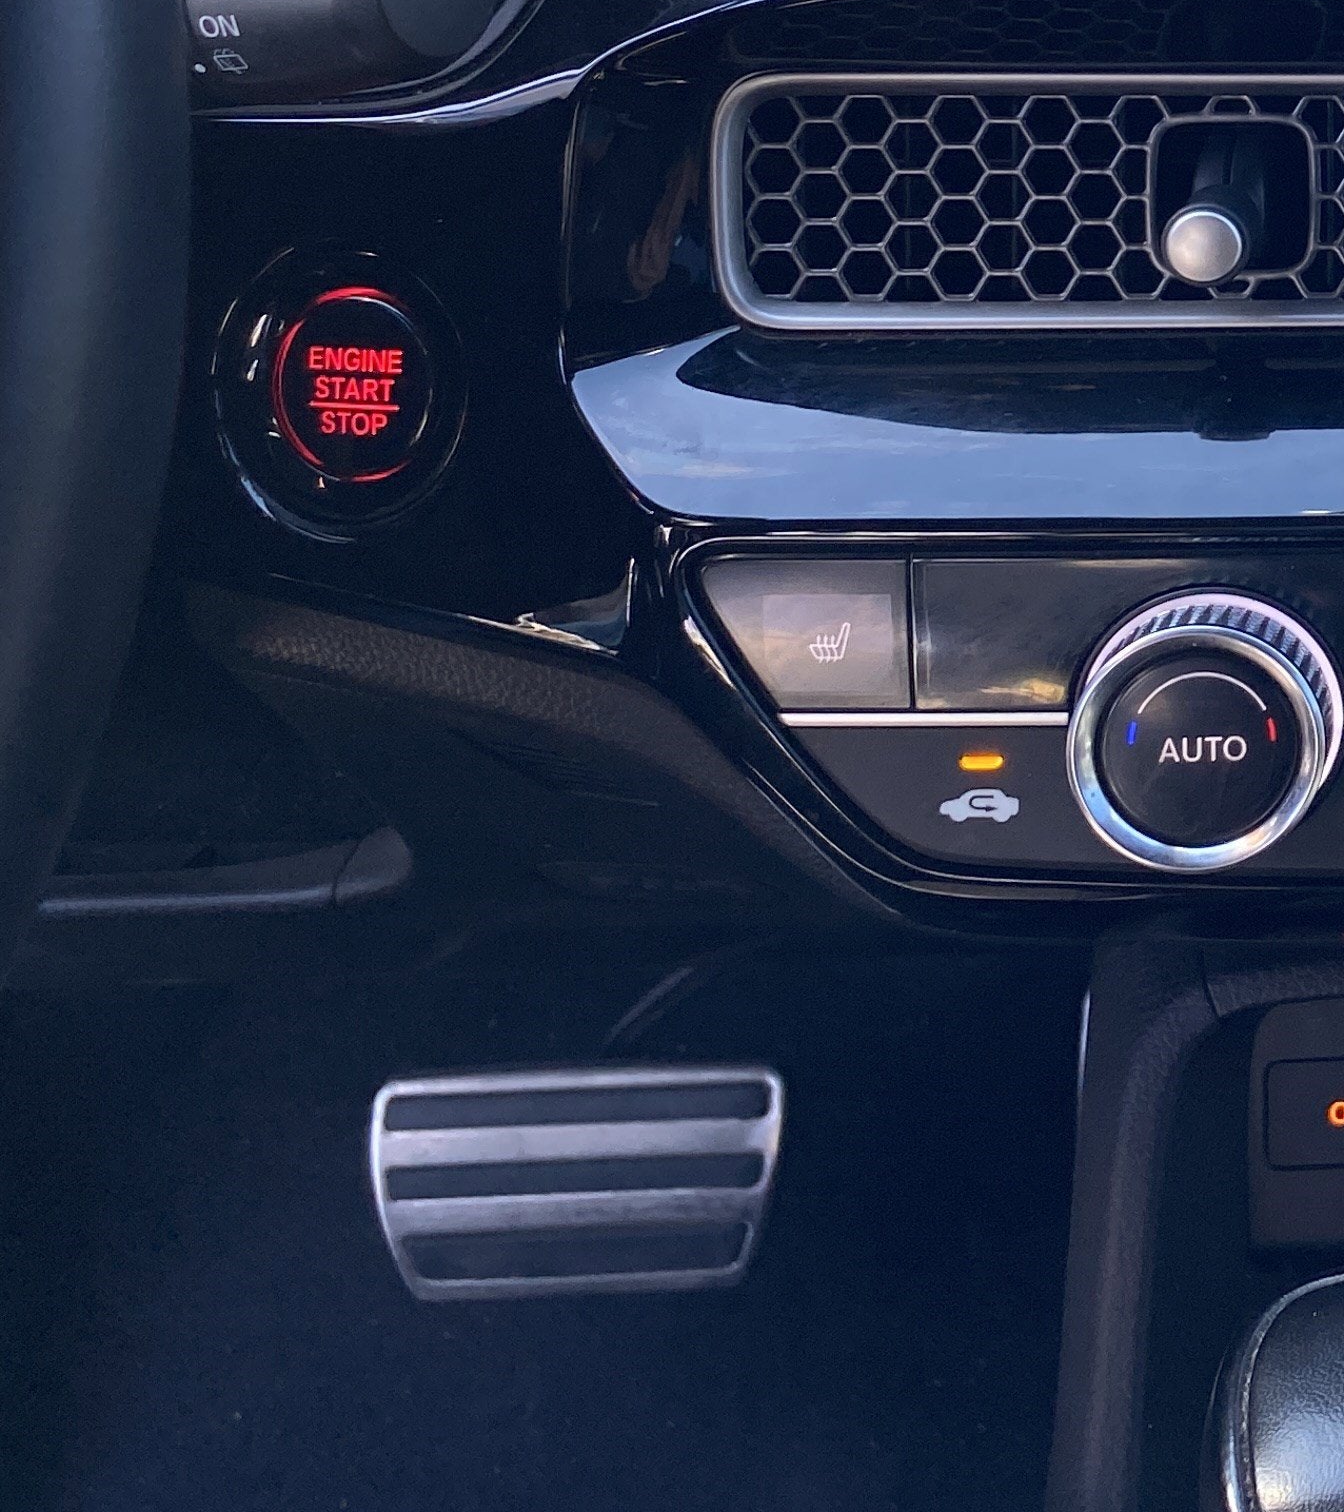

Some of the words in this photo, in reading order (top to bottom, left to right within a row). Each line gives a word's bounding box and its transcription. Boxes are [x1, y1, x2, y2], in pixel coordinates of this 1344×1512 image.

[199, 15, 240, 37] ON
[309, 347, 403, 374] ENGINE
[315, 376, 395, 402] START
[321, 410, 388, 436] STOP
[1158, 735, 1247, 763] AUTO
